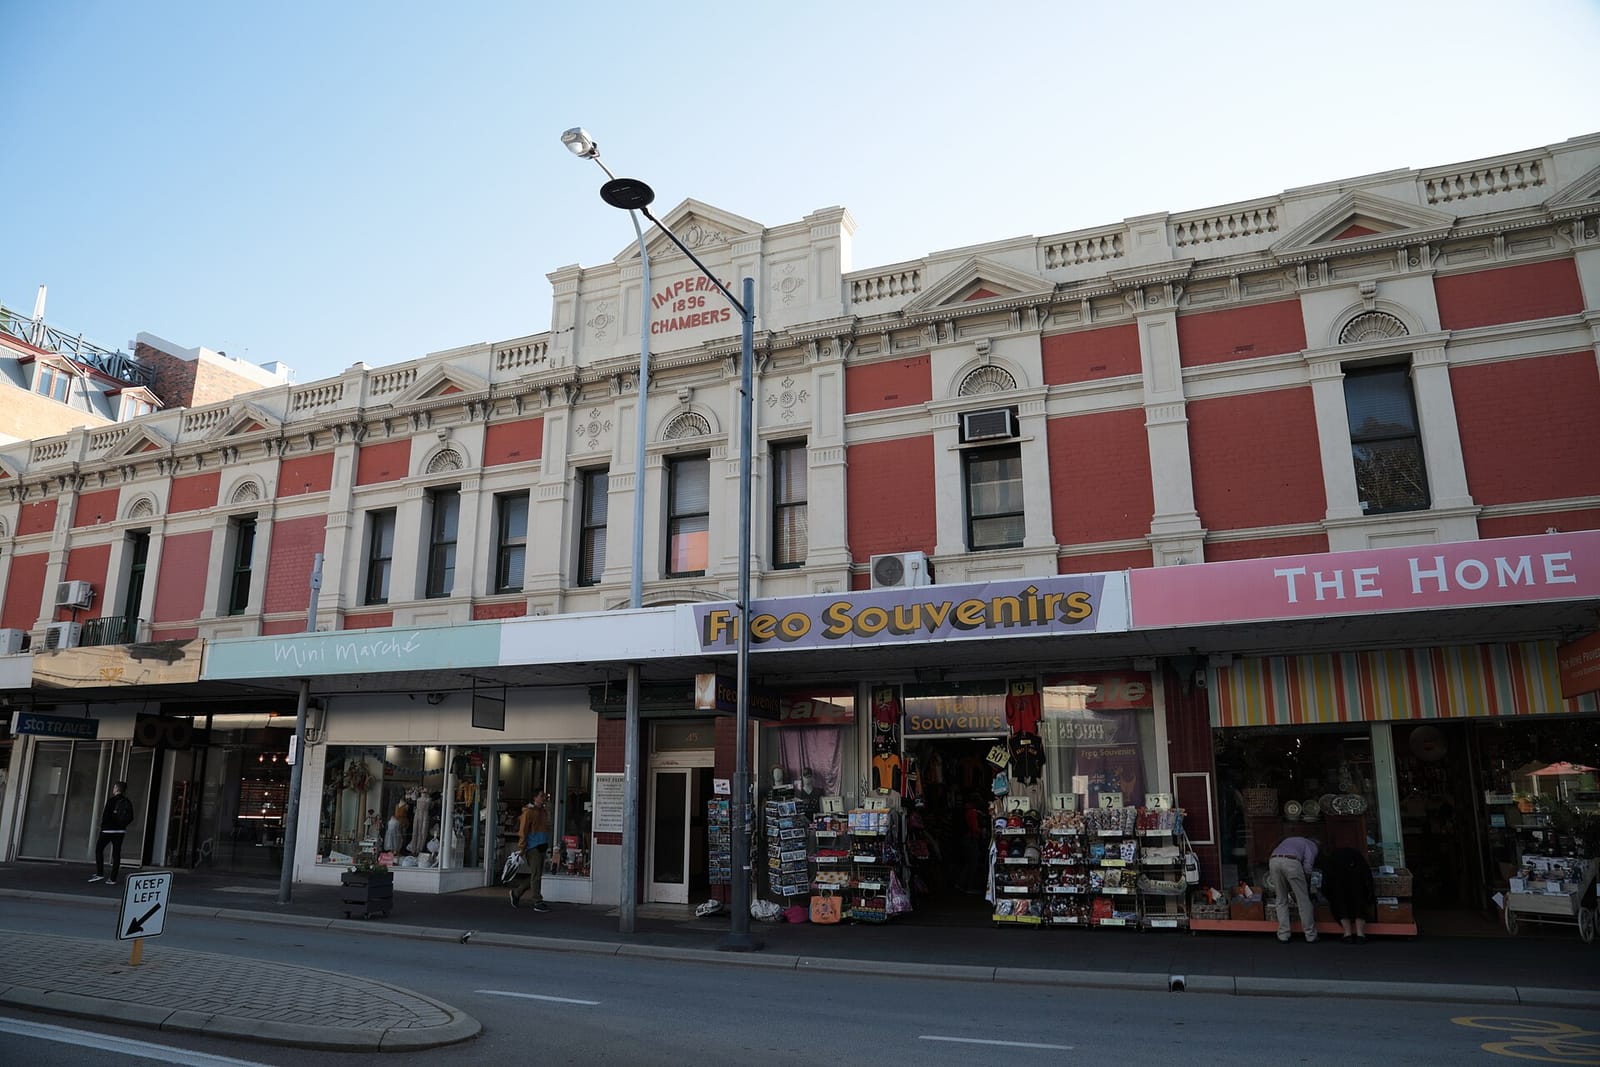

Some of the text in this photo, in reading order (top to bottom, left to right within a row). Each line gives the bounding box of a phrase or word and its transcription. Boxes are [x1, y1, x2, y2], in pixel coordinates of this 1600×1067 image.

[672, 296, 705, 312] 1896
[651, 307, 730, 334] CHAMBERS
[1273, 550, 1577, 603] THE HOME
[827, 585, 1092, 636] Souvenirs
[1057, 678, 1145, 704] ale
[23, 718, 93, 734] sta TRAVEL
[911, 715, 1002, 731] Souvenirs
[135, 878, 164, 890] KEEP
[133, 891, 161, 904] LEFT
